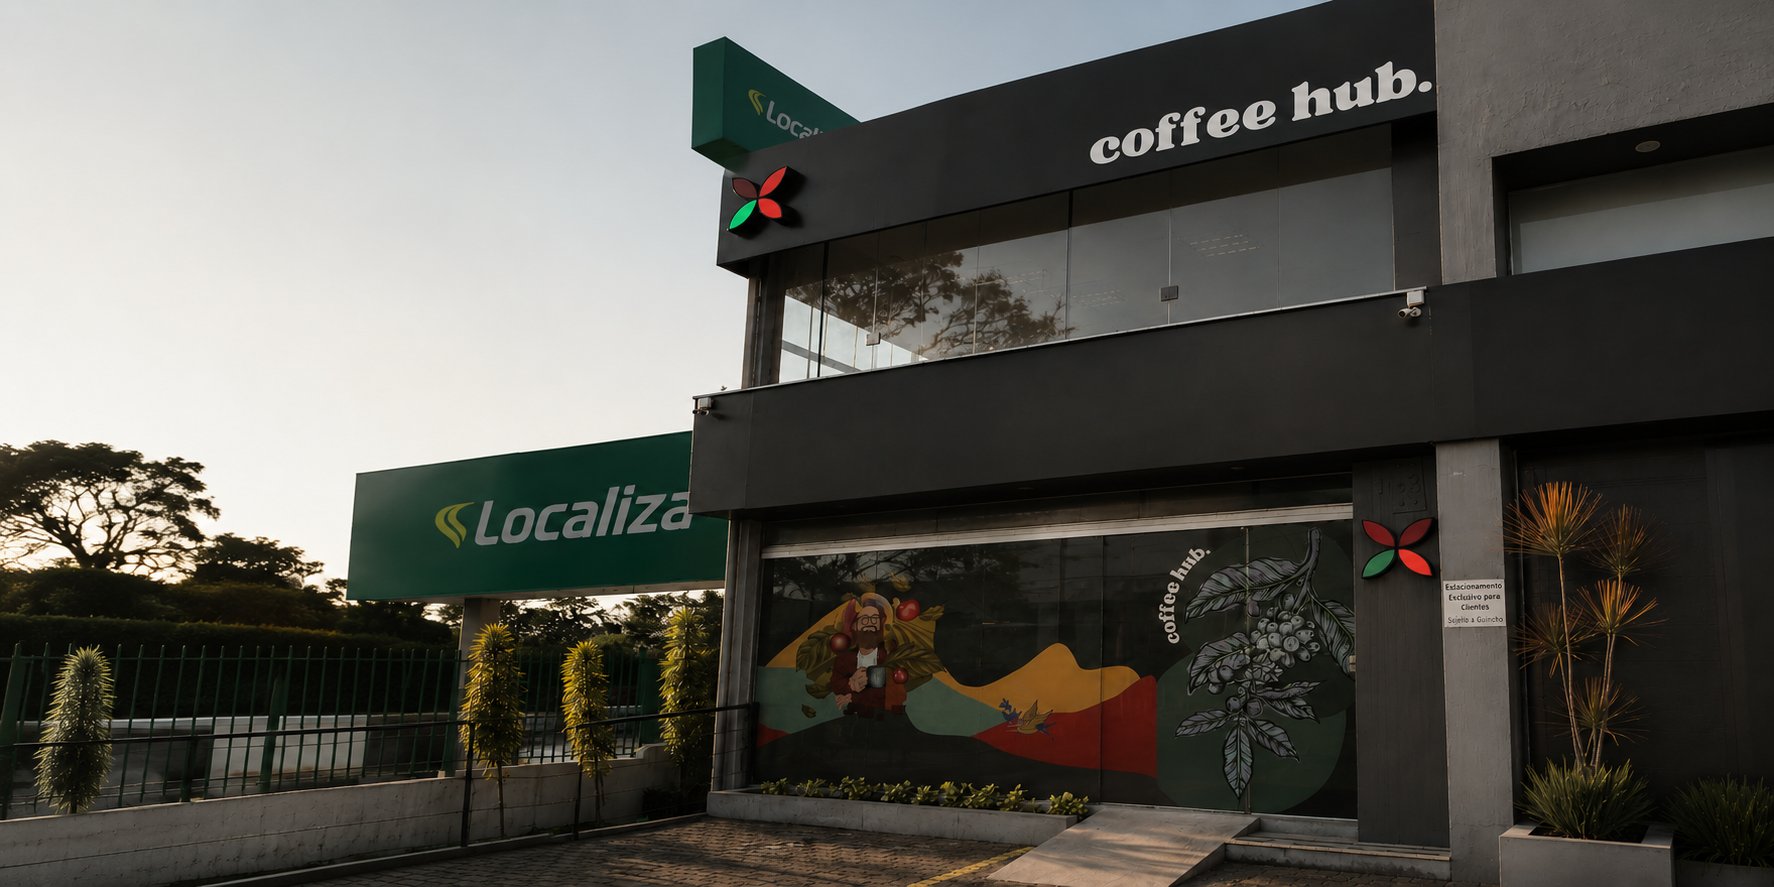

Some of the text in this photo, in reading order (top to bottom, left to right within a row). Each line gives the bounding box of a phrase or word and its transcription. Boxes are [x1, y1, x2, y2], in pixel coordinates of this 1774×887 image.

[766, 100, 824, 139] Loca
[1090, 61, 1433, 165] coffee hub.
[474, 484, 693, 546] Localiza
[1158, 548, 1212, 644] coffee hub.
